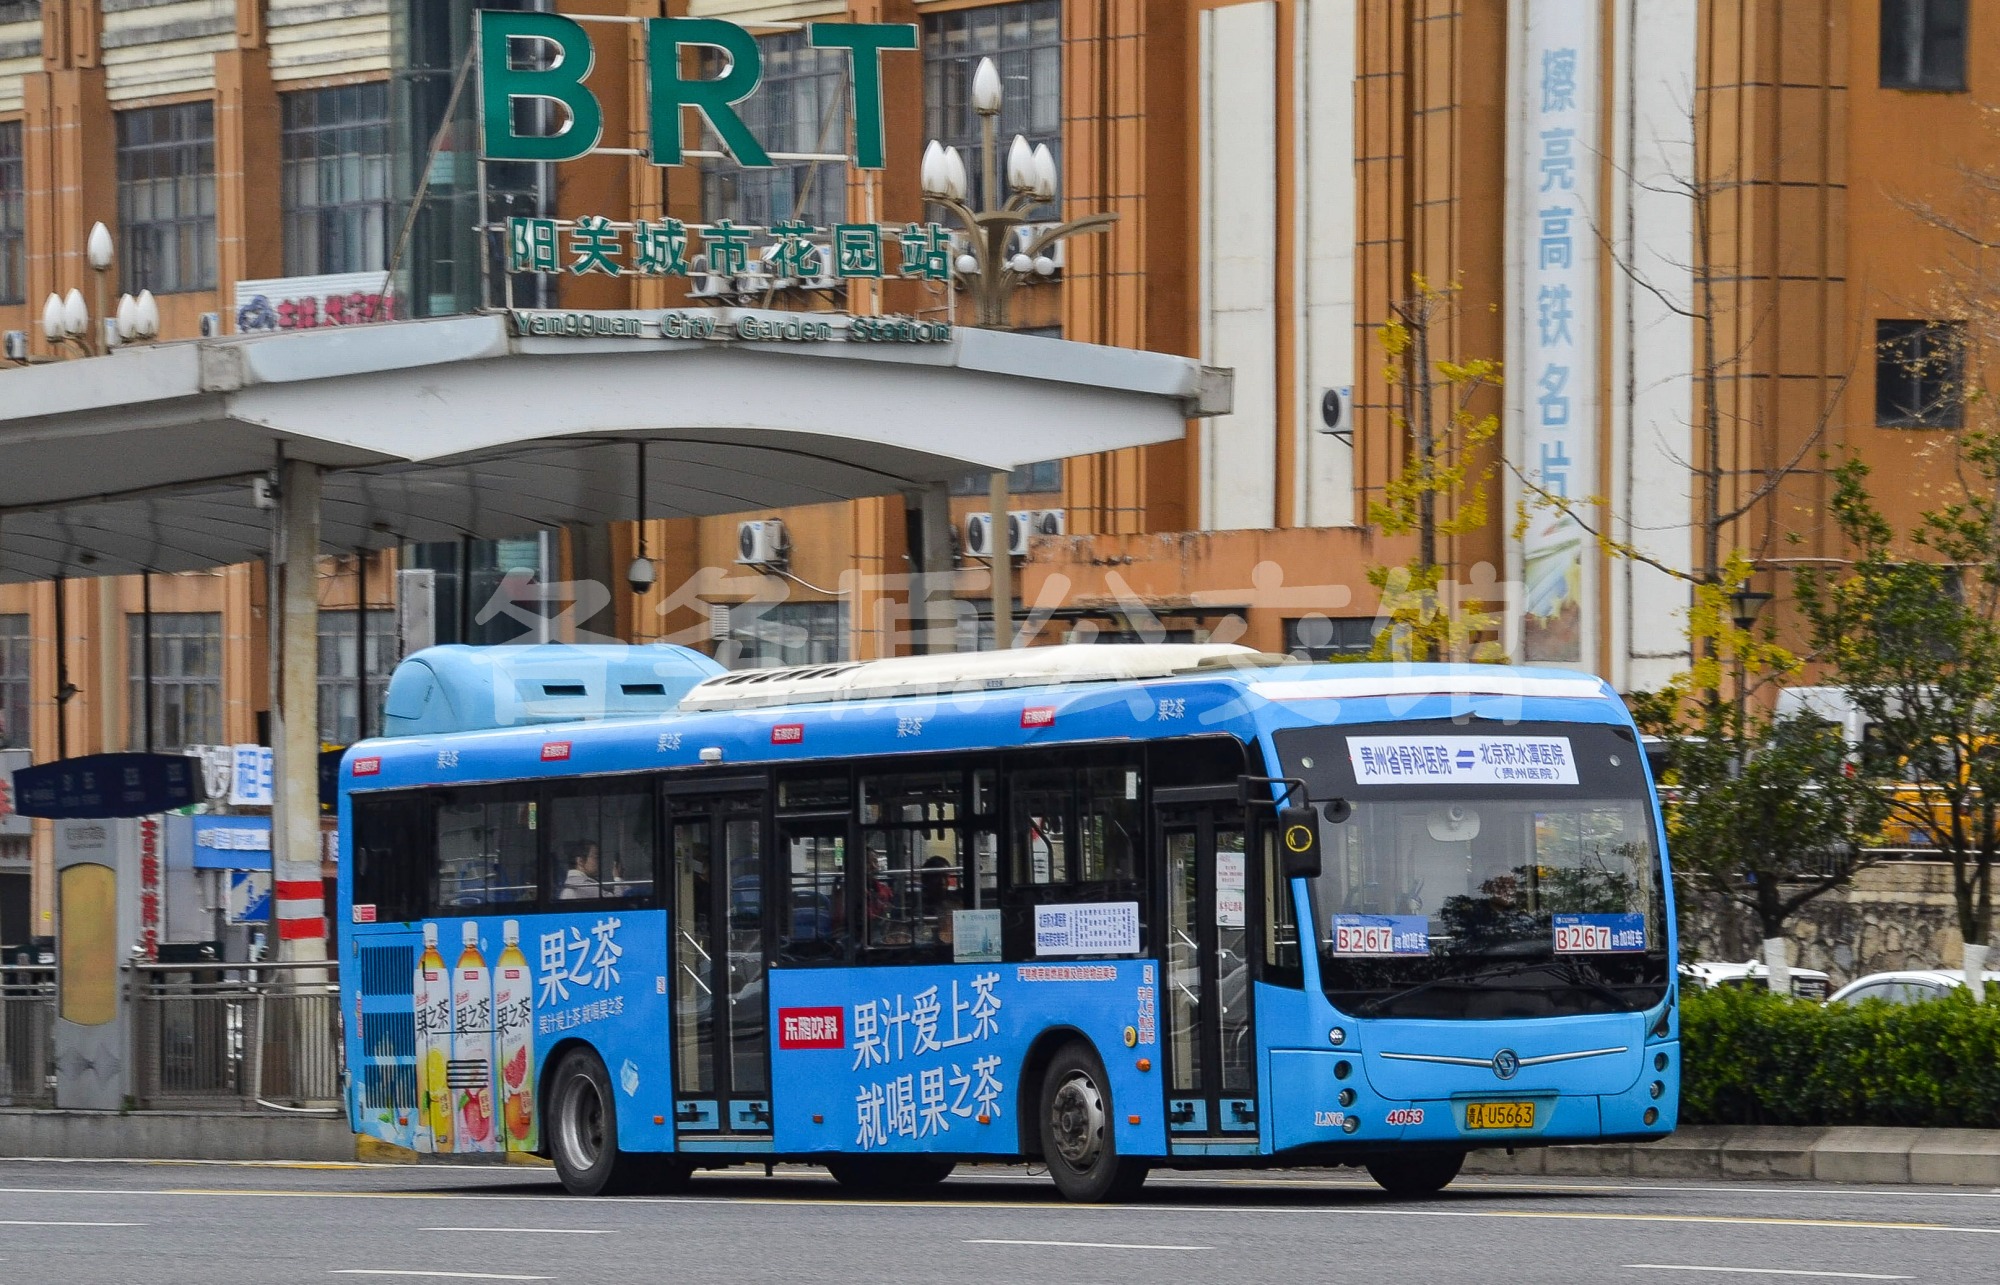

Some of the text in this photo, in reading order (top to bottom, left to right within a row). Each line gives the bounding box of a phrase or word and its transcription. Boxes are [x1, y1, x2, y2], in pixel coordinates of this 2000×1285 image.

[474, 9, 919, 170] BRT
[508, 214, 951, 281] 阳关城市花园站
[1538, 48, 1578, 497] 擦亮高铁名片
[515, 310, 950, 343] Yangguan City Garden Station
[896, 716, 923, 738] 果之茶
[1157, 698, 1186, 722] 果之茶
[656, 732, 683, 753] 果之茶
[1359, 742, 1566, 776] 贵州省骨科医院 北京积水潭医院
[1338, 929, 1428, 949] B267 路加班车
[1557, 928, 1643, 949] B267 路加班车
[537, 917, 623, 1009] 果之茶
[416, 998, 449, 1040] 果之茶
[456, 997, 491, 1041] 果之茶
[496, 996, 531, 1041] 果之茶
[538, 996, 624, 1036] 果汁爱上茶 就喝果之茶
[783, 1015, 838, 1042] 东鹏饮料
[852, 971, 1002, 1072] 果汁爱上茶
[855, 1054, 1003, 1151] 就喝果之茶
[1314, 1111, 1344, 1127] LNG
[1386, 1109, 1424, 1125] 4053
